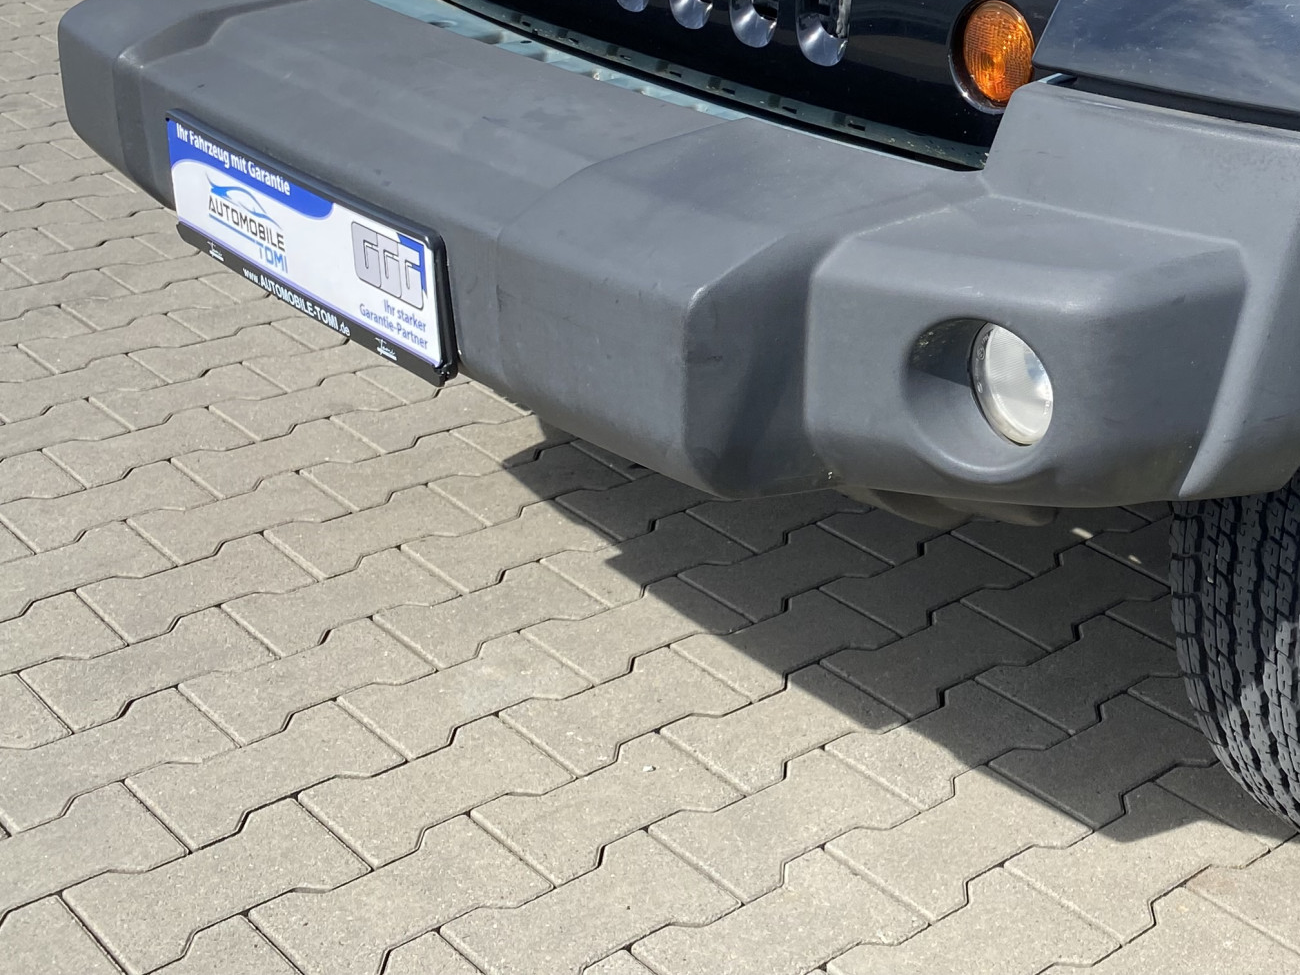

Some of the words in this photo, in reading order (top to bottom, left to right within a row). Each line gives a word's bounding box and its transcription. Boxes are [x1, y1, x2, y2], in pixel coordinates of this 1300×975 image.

[176, 123, 188, 143] Ihr
[189, 130, 230, 168] Fahrzeug
[230, 154, 247, 174] mit
[247, 161, 291, 195] Garantie
[208, 195, 286, 252] AUTOMOBILE
[256, 241, 288, 273] TOMI
[359, 303, 429, 350] Garantie-Partner
[384, 299, 395, 316] Ihr
[397, 309, 427, 332] starker
